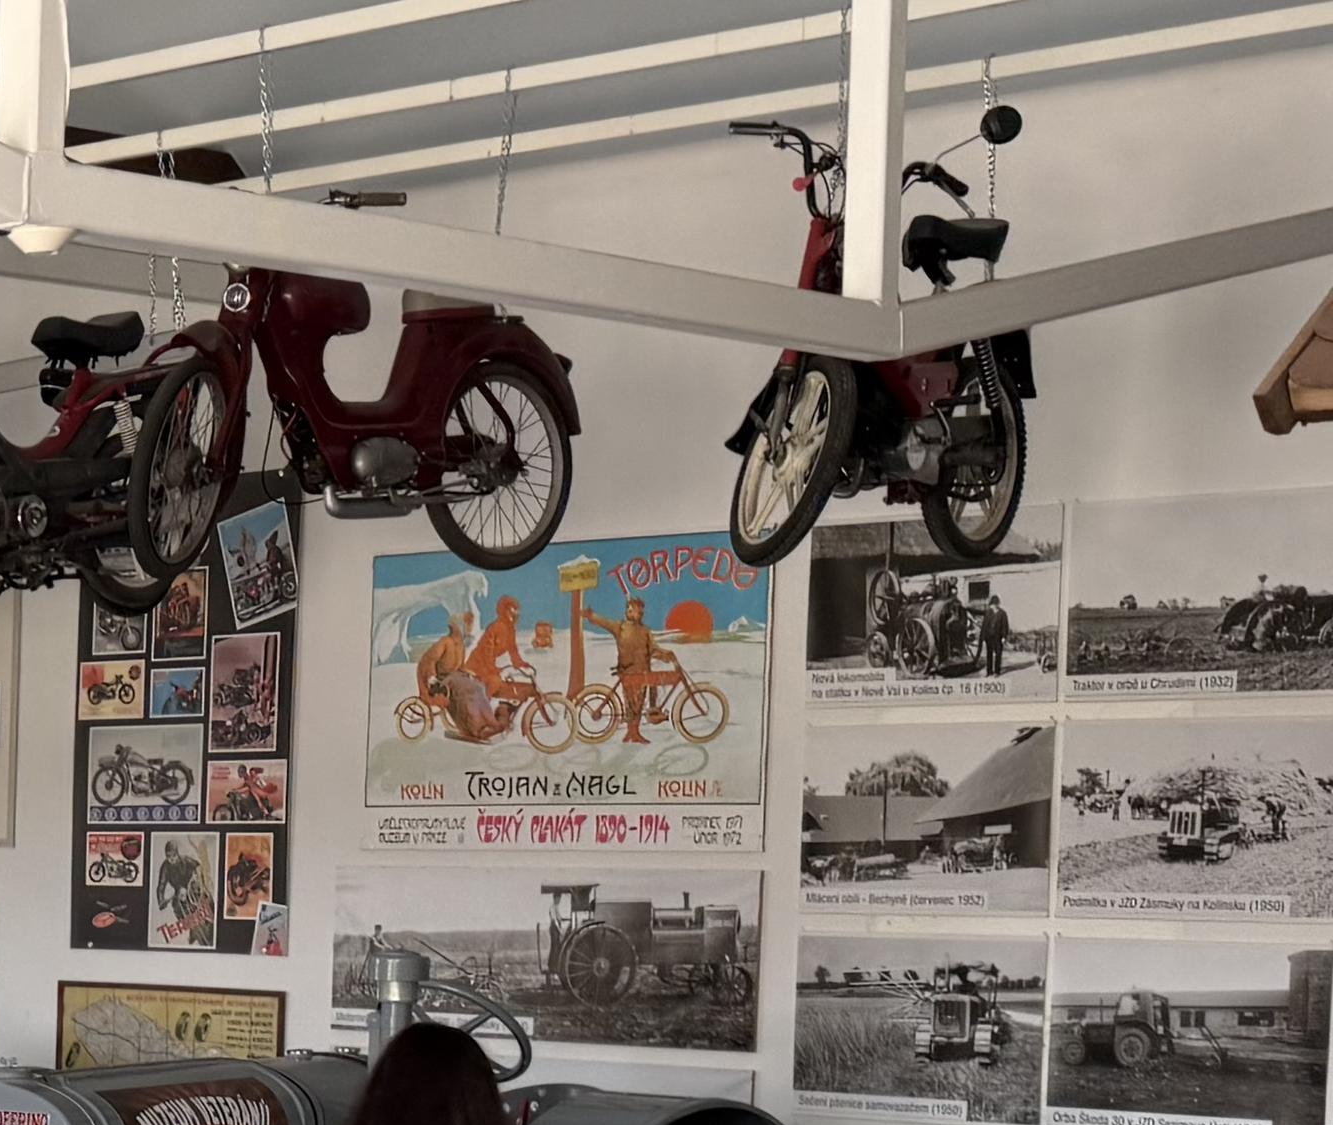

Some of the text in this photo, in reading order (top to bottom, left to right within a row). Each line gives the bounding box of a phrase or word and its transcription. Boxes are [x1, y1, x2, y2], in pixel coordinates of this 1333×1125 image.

[608, 545, 760, 598] TORPEDO
[1072, 680, 1104, 691] Traktor
[1200, 675, 1235, 690] (1932)
[465, 771, 548, 800] TROJAN
[566, 771, 637, 798] NAGL
[477, 808, 524, 844] ČESKÝ
[530, 808, 588, 844] PLAKÁT
